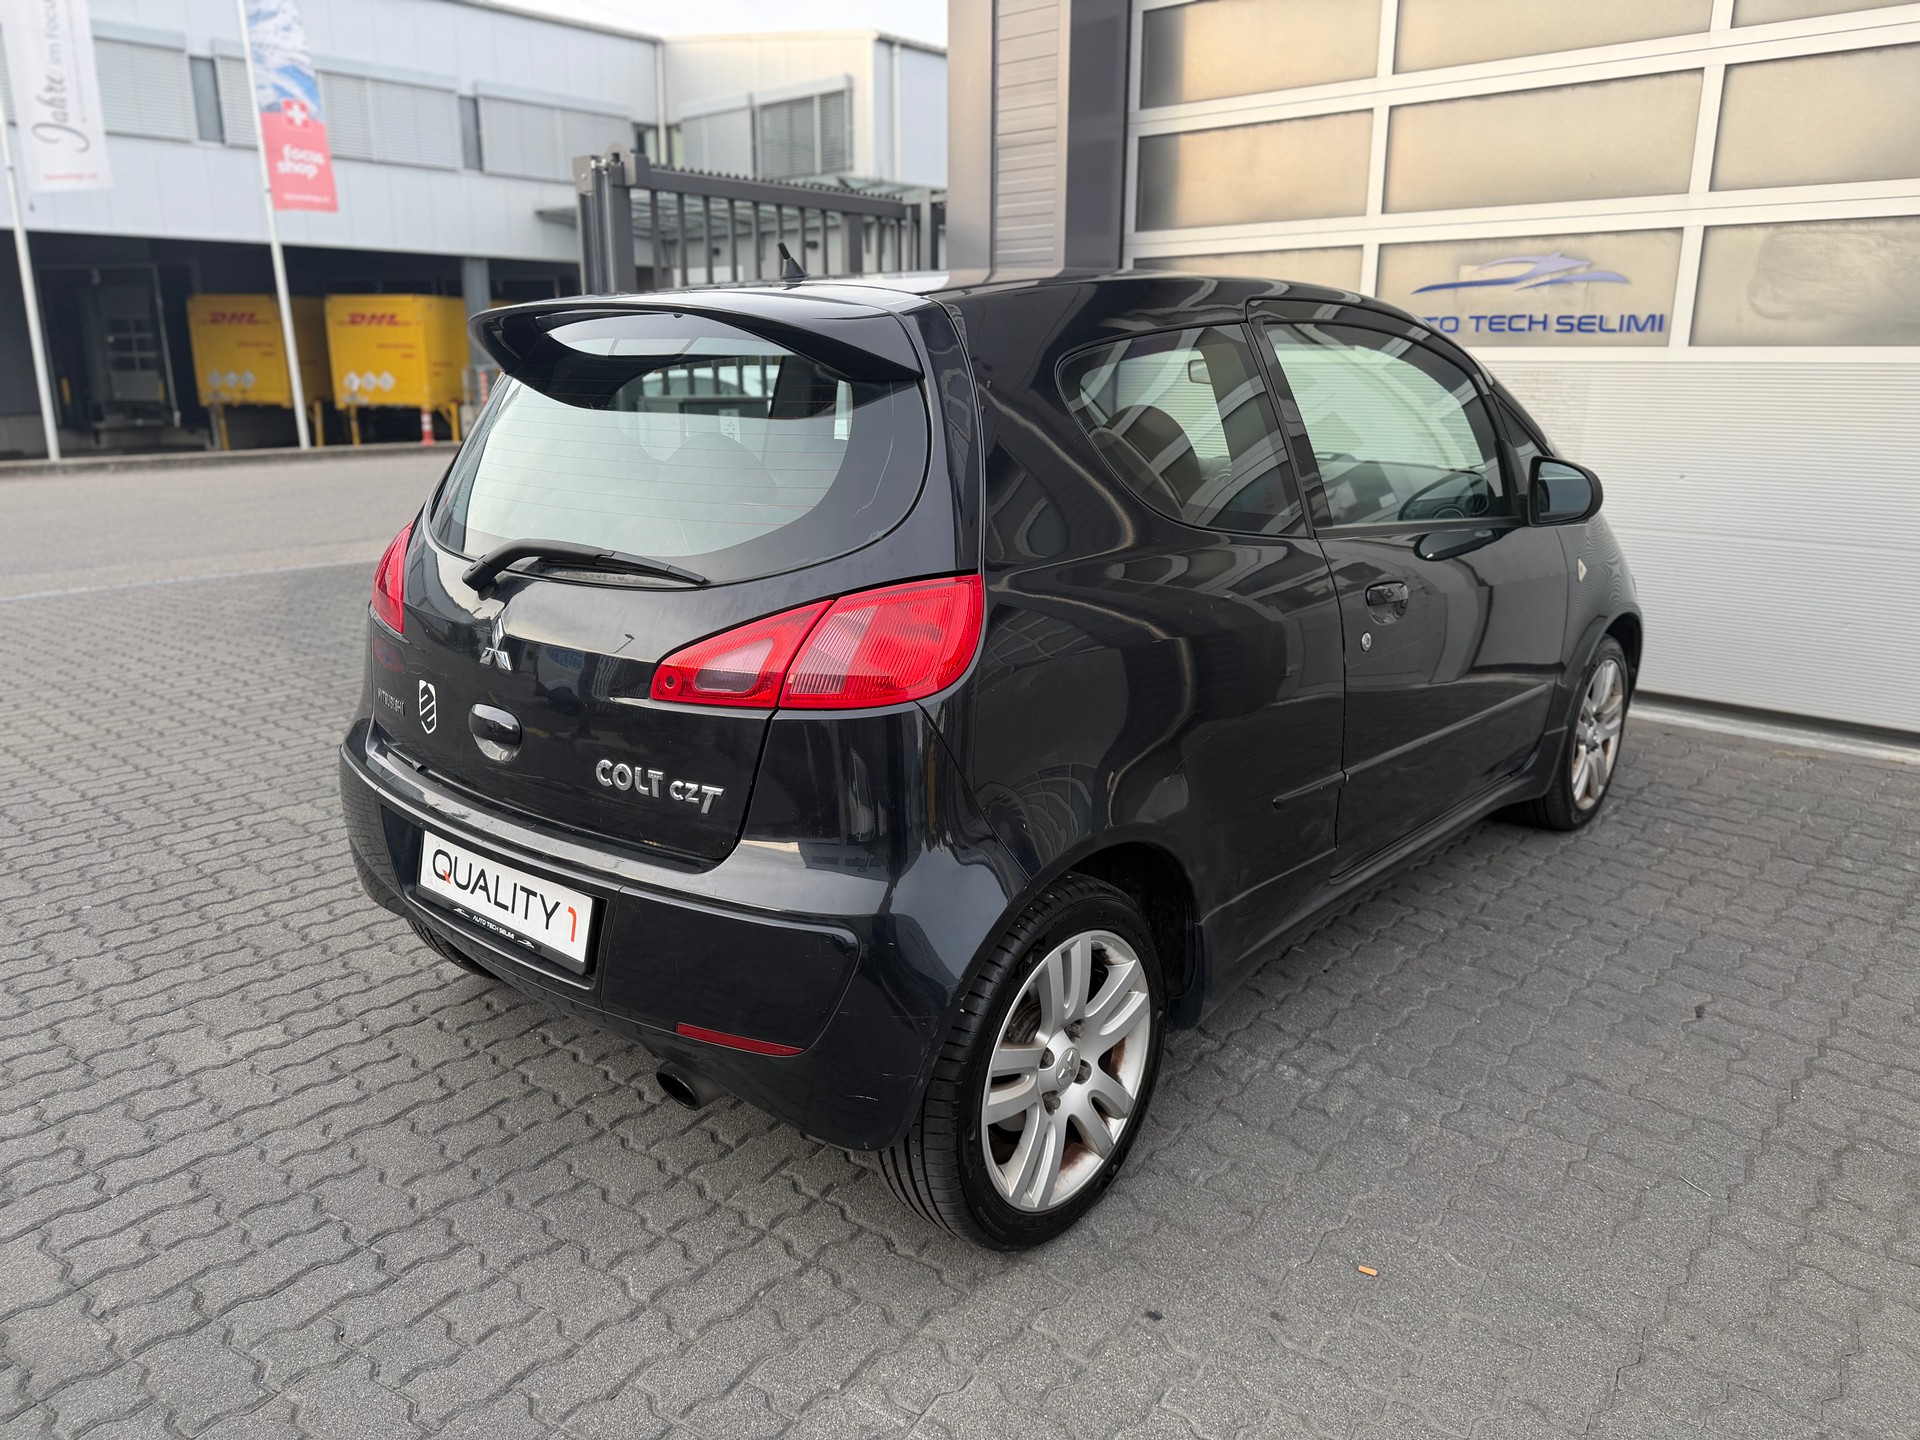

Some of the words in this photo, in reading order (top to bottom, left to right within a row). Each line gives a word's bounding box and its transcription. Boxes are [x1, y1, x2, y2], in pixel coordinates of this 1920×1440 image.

[209, 311, 258, 325] DHL
[348, 312, 400, 326] DHL
[1468, 314, 1548, 333] TECH
[1555, 314, 1665, 333] SELIMI
[595, 759, 664, 798] COLT
[669, 780, 725, 814] CZT
[473, 915, 487, 926] AUTO
[486, 921, 500, 932] TECH
